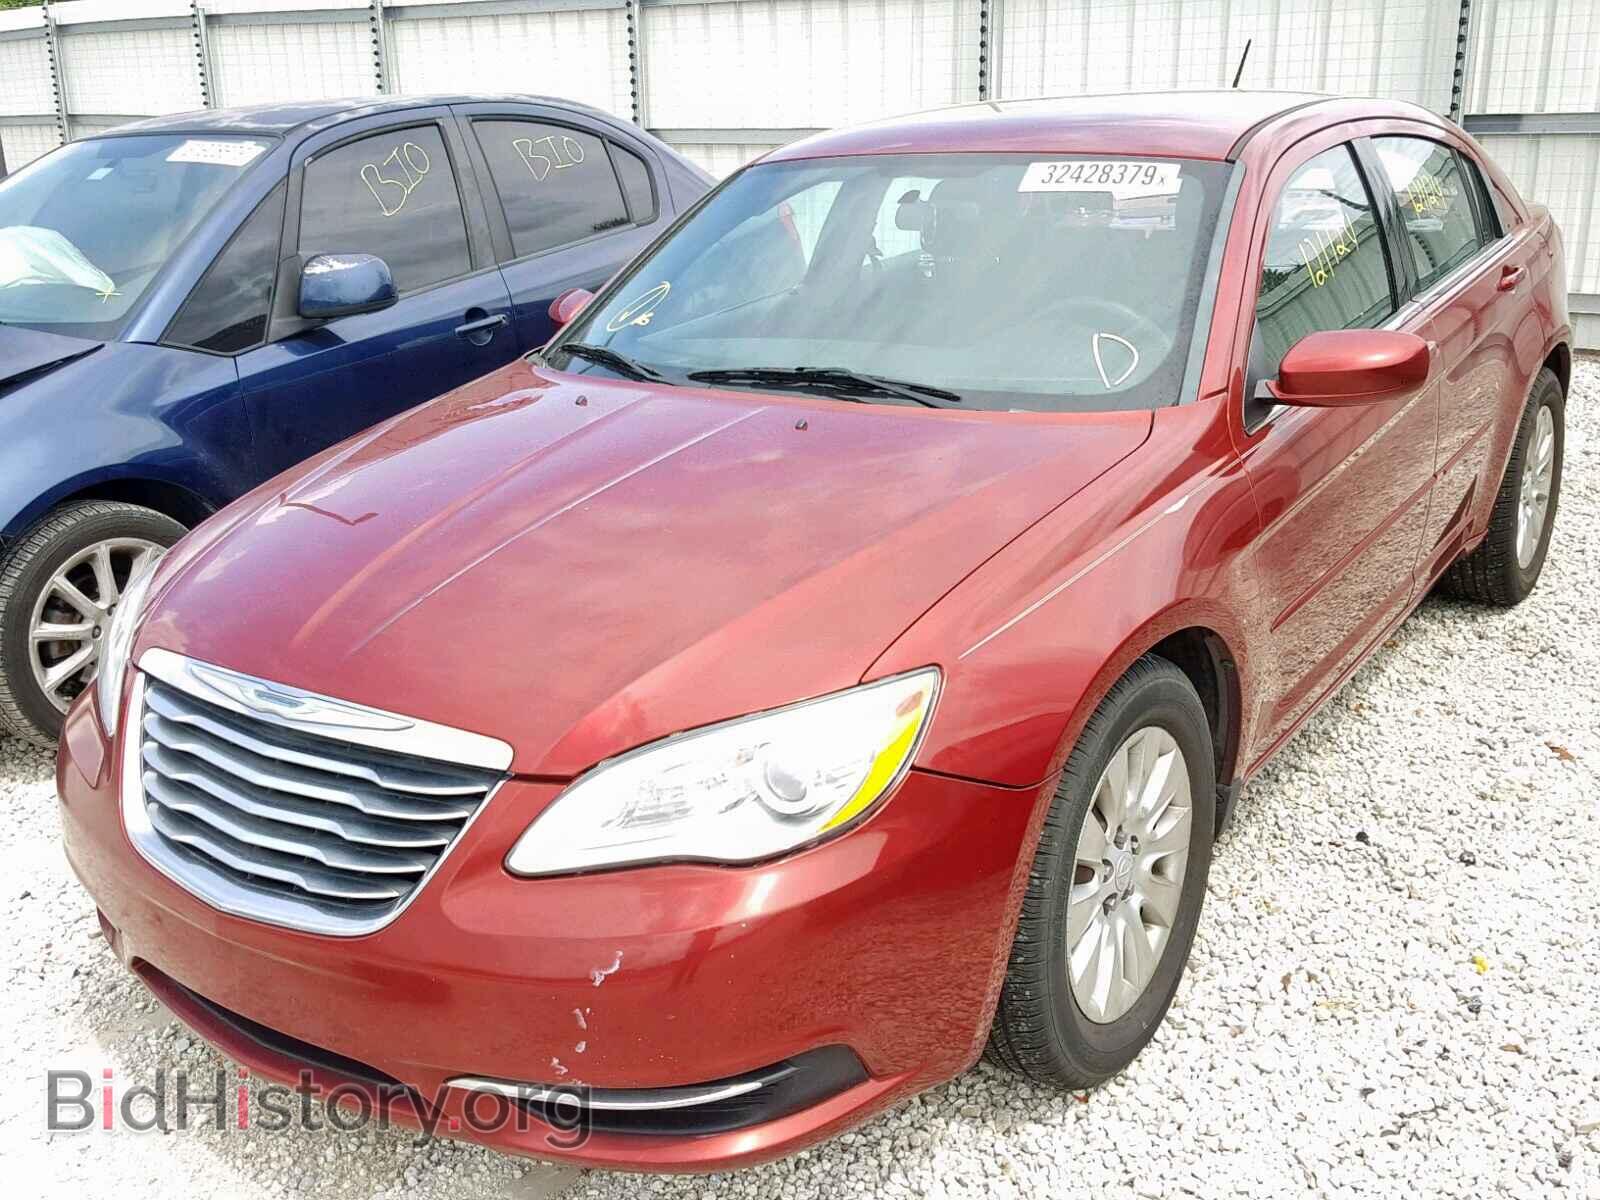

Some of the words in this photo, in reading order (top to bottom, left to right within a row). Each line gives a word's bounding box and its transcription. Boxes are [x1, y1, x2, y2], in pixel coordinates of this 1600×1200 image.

[360, 142, 430, 216] BIO
[512, 135, 584, 181] BIO
[1040, 163, 1158, 185] 32428379
